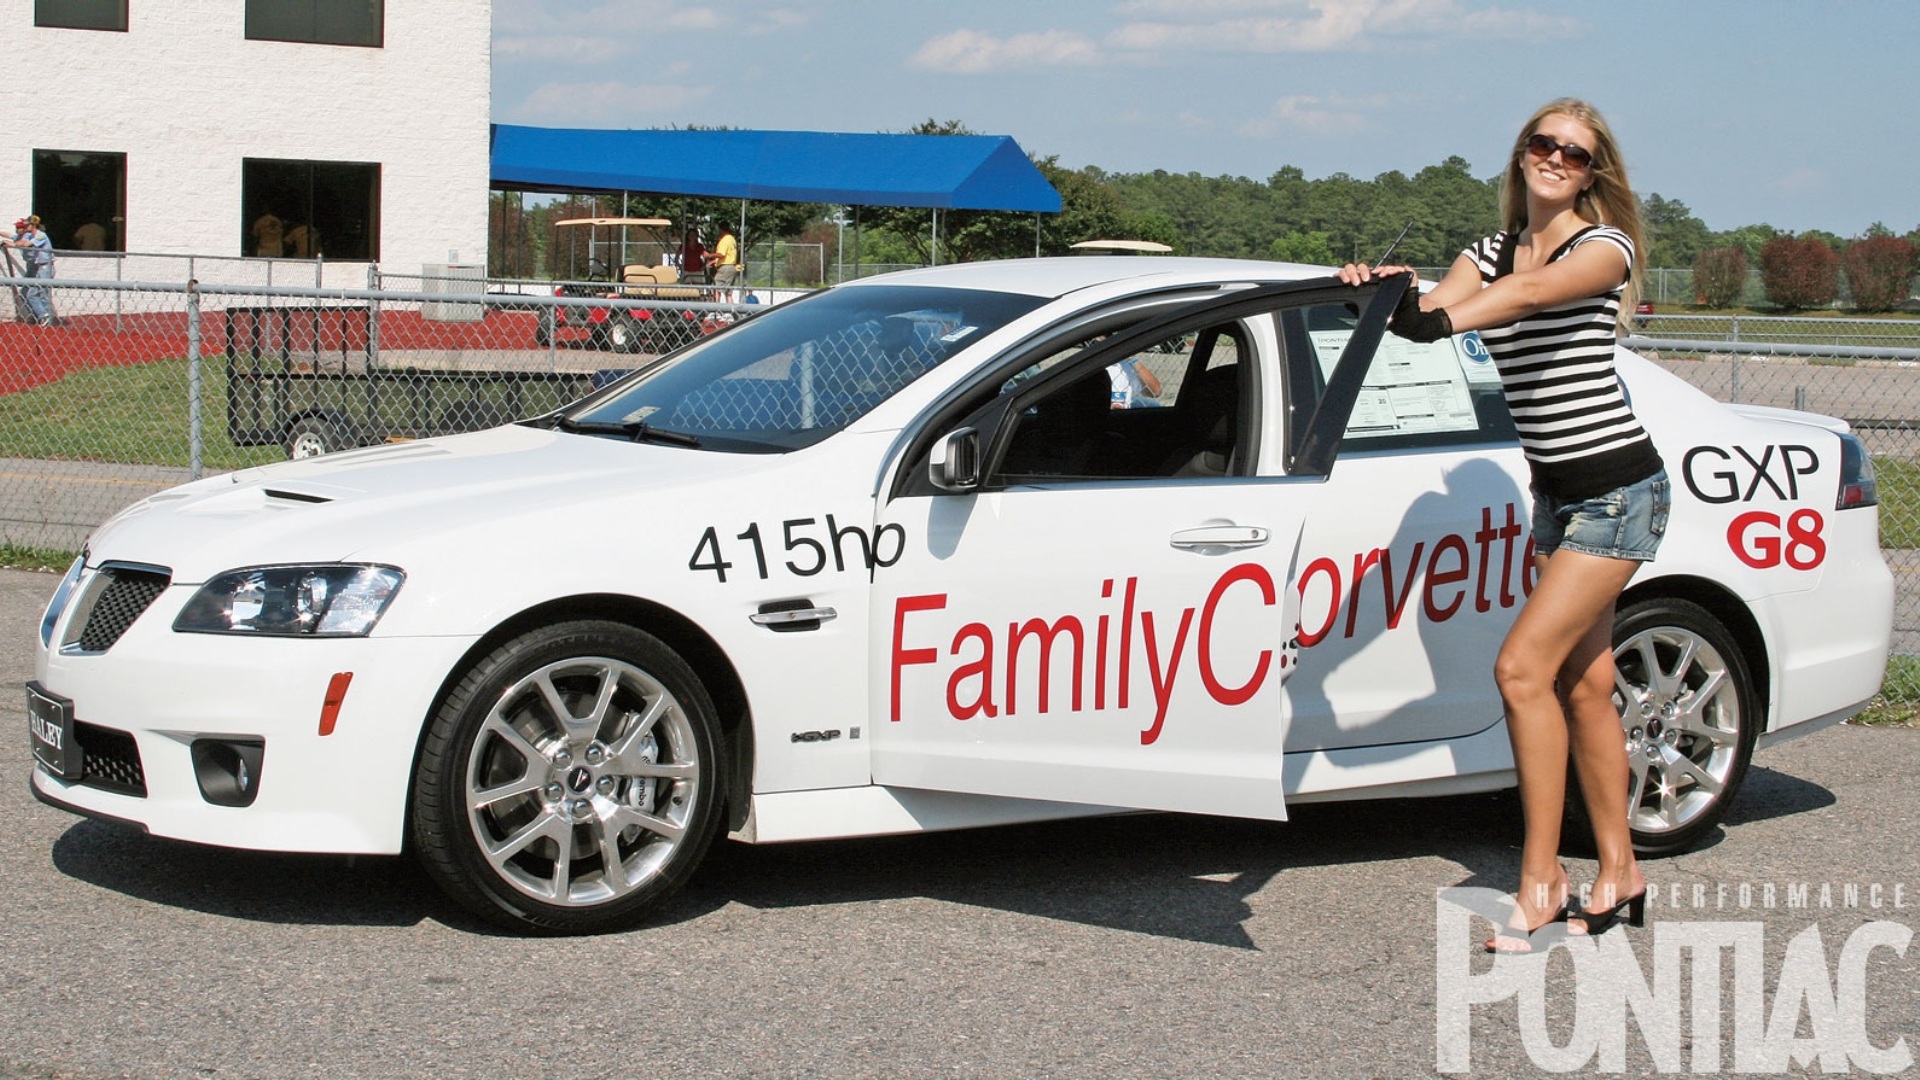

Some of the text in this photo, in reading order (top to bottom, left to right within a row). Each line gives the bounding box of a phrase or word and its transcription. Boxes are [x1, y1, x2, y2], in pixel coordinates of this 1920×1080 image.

[1682, 445, 1819, 504] GXP
[688, 514, 905, 583] 415hp
[1727, 508, 1826, 571] G8
